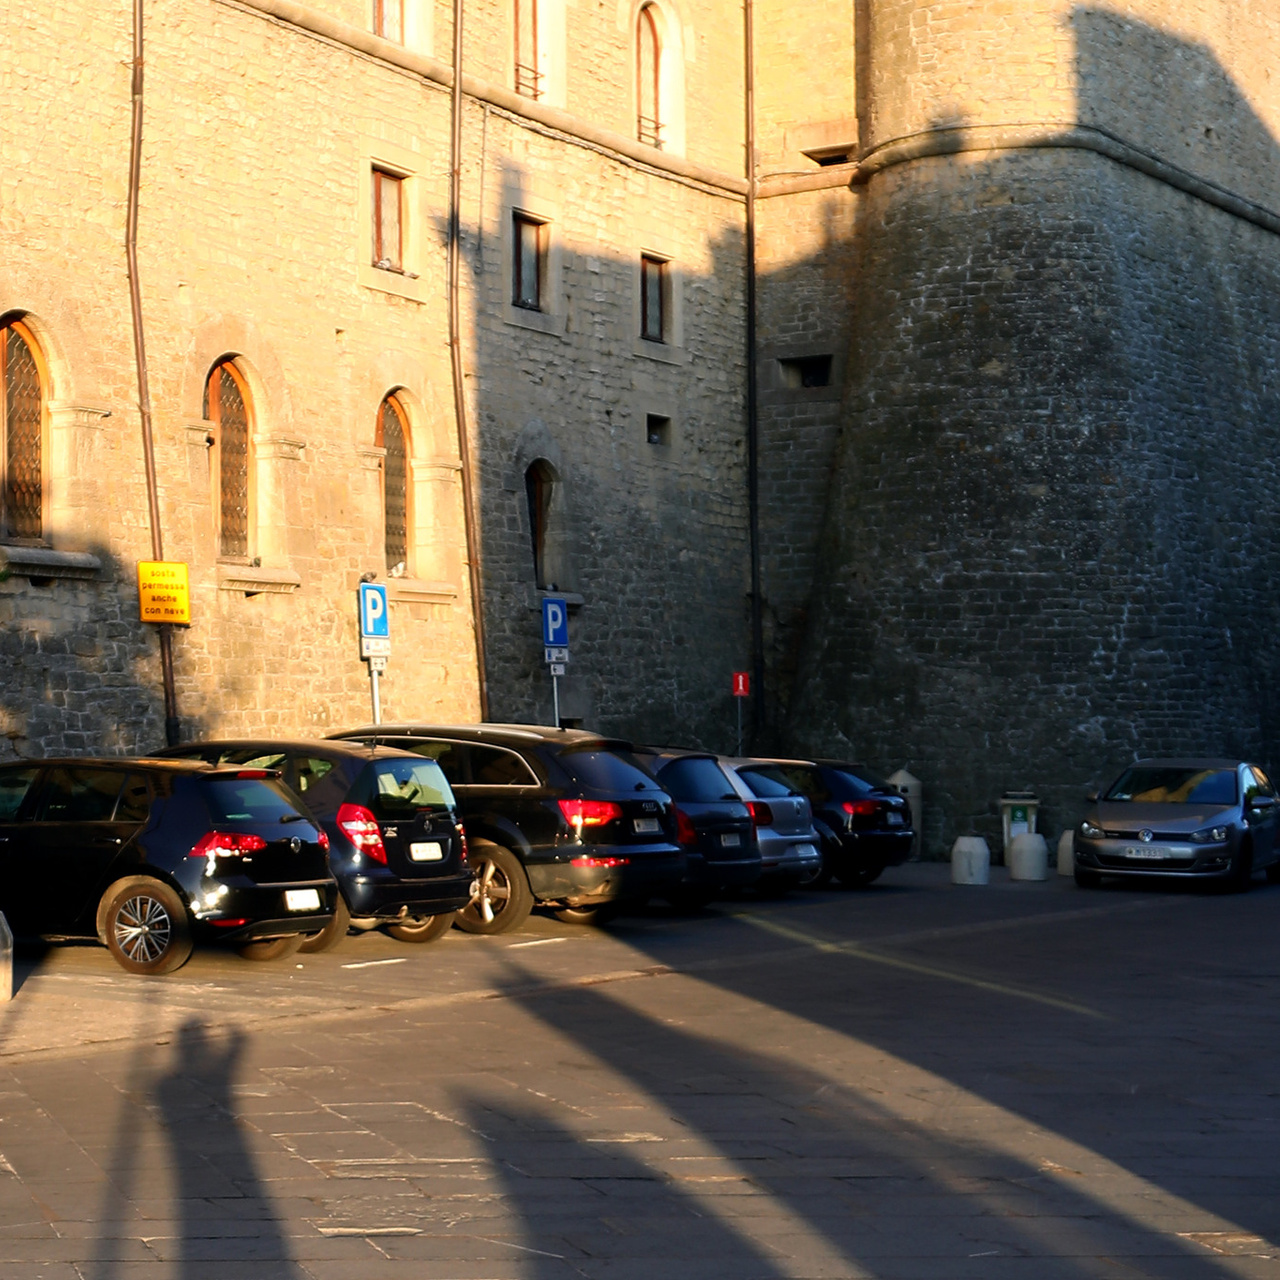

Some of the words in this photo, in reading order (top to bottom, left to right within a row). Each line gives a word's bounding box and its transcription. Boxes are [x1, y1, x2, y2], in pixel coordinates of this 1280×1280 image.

[142, 582, 184, 590] permessa
[151, 593, 177, 602] anche
[365, 588, 383, 632] P
[547, 603, 562, 642] P
